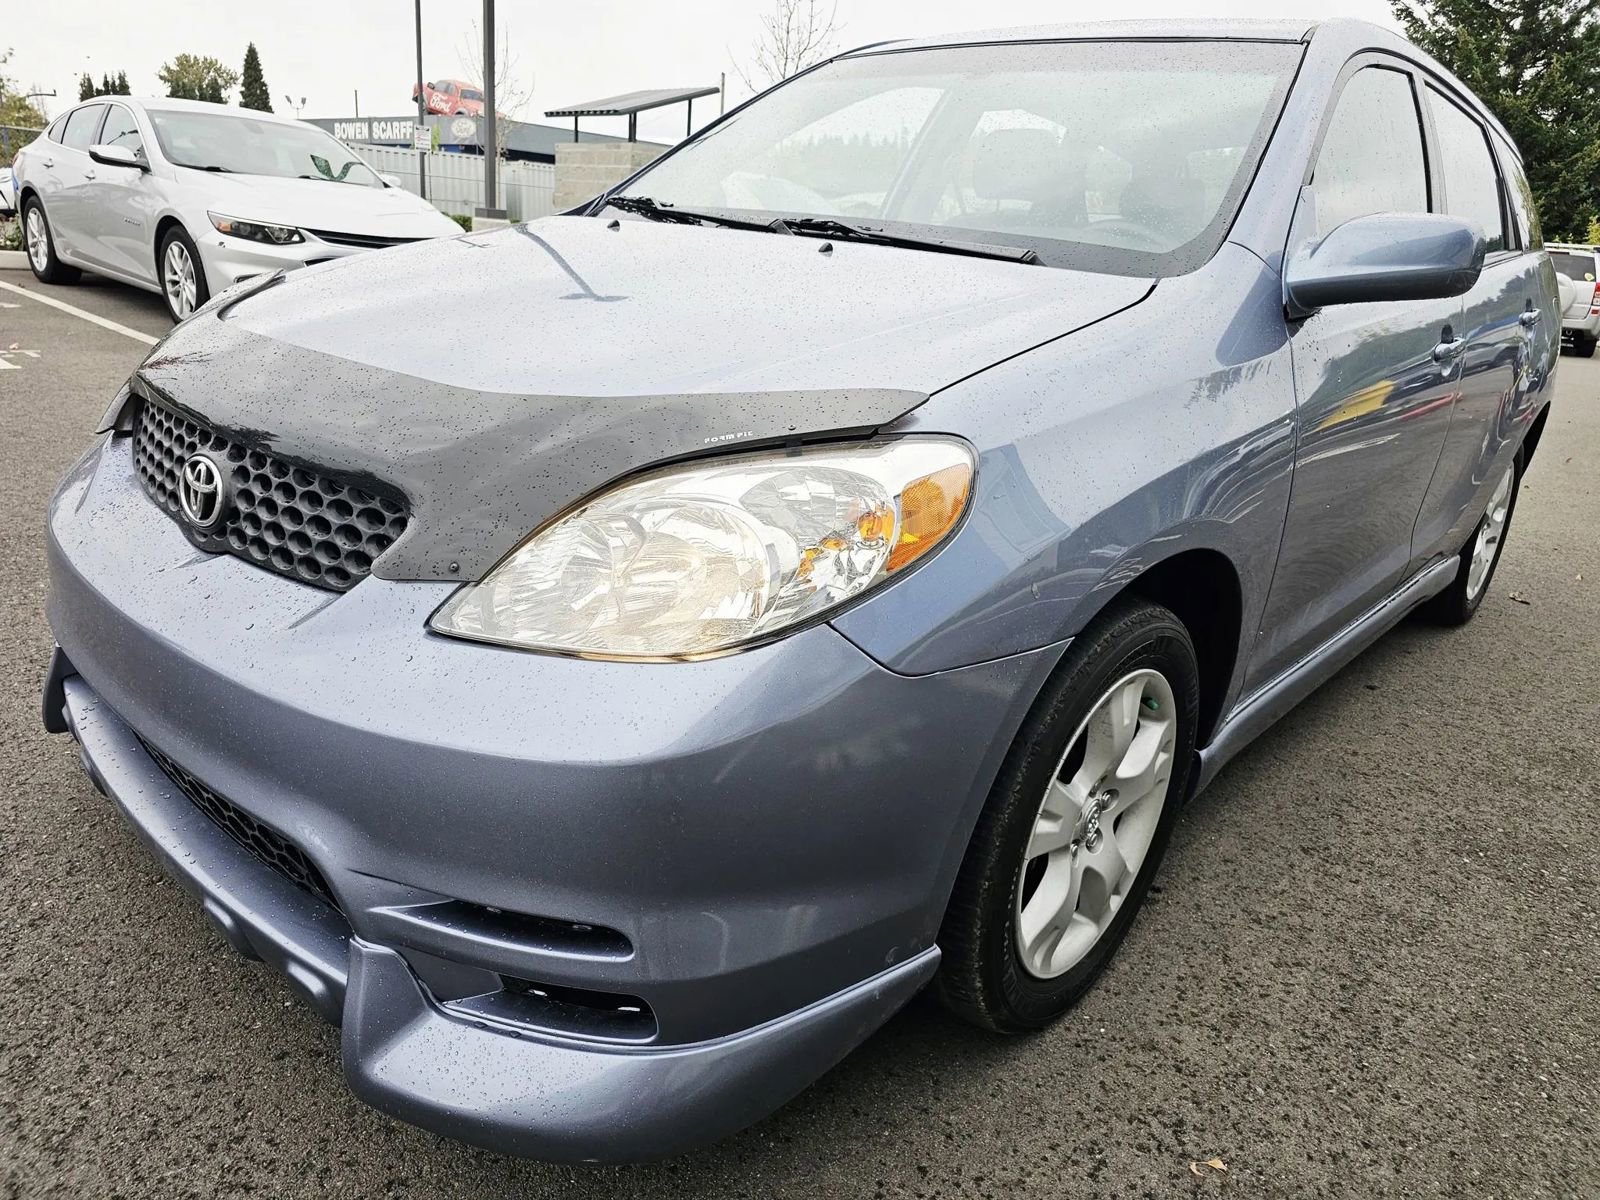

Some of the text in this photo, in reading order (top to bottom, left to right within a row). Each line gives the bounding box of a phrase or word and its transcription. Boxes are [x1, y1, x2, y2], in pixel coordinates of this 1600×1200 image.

[430, 92, 452, 113] Ford
[334, 121, 369, 140] BOWEN
[372, 120, 414, 140] SCARFF
